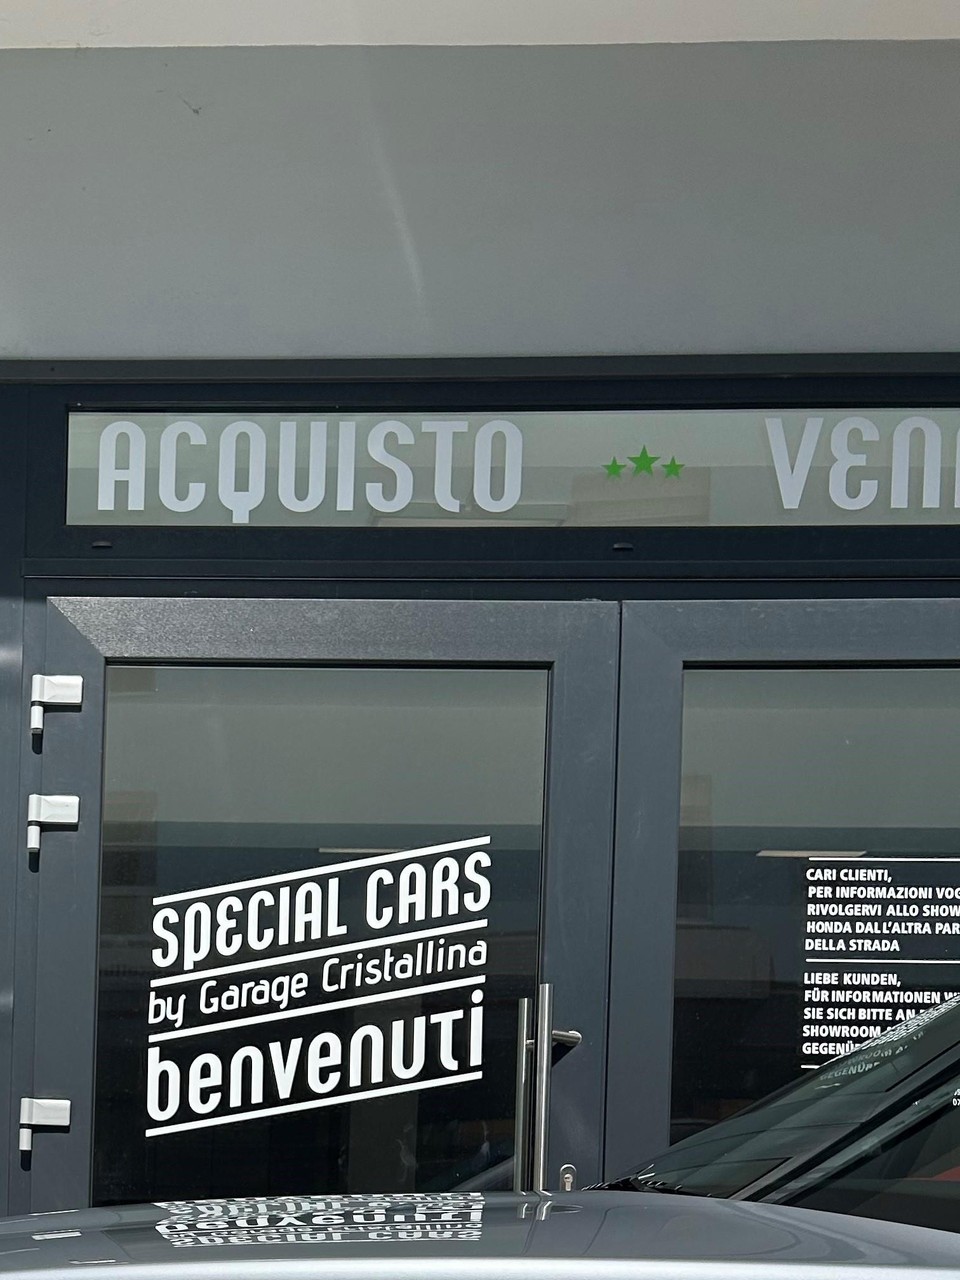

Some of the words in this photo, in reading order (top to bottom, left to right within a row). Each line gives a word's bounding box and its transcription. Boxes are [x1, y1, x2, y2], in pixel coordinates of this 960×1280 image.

[765, 416, 960, 511] VEN
[97, 420, 523, 524] ACQUISTO
[805, 868, 837, 881] CARI
[840, 869, 893, 883] CLIENTI,
[808, 886, 832, 899] PER
[836, 886, 933, 899] INFORMAZIONI
[152, 877, 348, 972] SPECIAL
[366, 851, 492, 930] CARS
[807, 903, 882, 916] RIVOLGERVI
[886, 904, 919, 917] ALLO
[806, 921, 852, 934] HONDA
[935, 922, 960, 935] PAR
[805, 938, 847, 951] DELLA
[849, 939, 900, 951] STRADA
[148, 991, 186, 1028] by
[199, 972, 309, 1010] Garage
[322, 938, 488, 993] Cristallina
[803, 972, 839, 985] LIEBE
[843, 973, 901, 987] KUNDEN,
[804, 988, 829, 1003] FÜR
[831, 990, 941, 1004] INFORMATIONEN
[803, 1007, 824, 1020] SIE
[826, 1008, 856, 1020] SICH
[858, 1008, 892, 1020] BITTE
[895, 1009, 916, 1021] AN
[802, 1025, 882, 1038] SHOWROOM
[802, 1040, 862, 1055] GEGENÜ
[146, 989, 484, 1122] benvenuti
